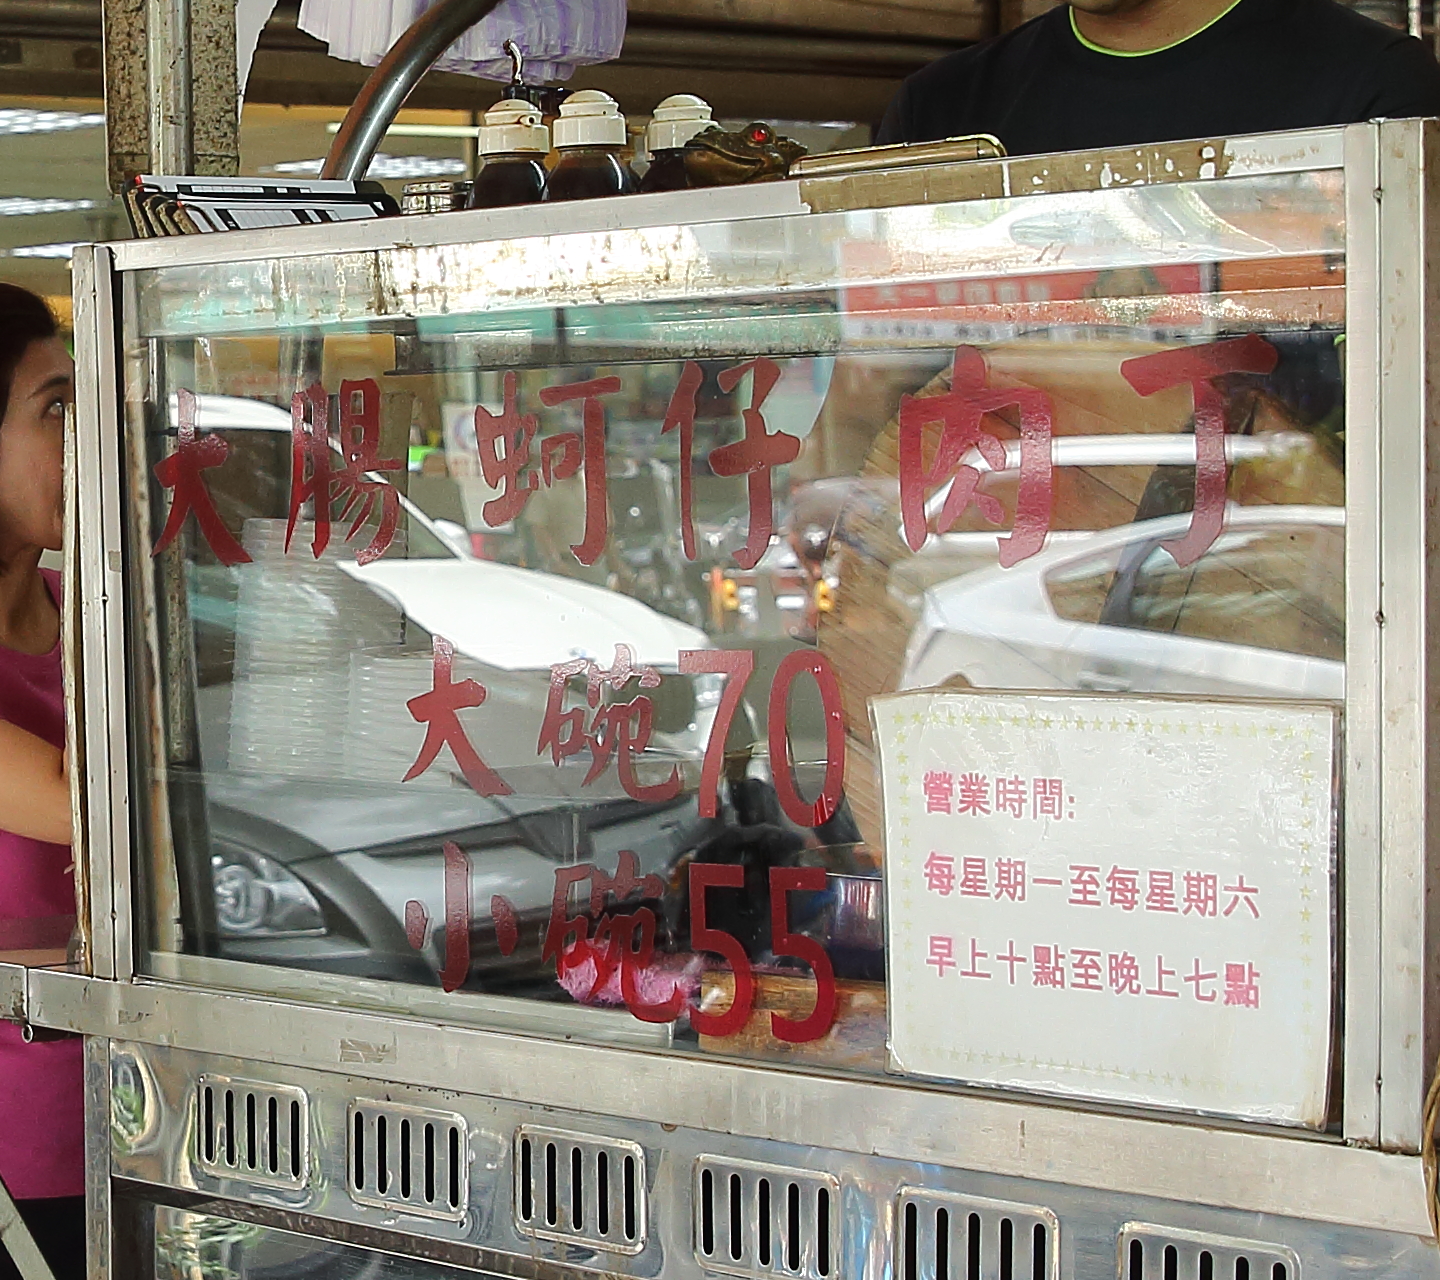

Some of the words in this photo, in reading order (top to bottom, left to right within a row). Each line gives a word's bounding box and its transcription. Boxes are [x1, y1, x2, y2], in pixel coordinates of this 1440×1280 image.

[922, 850, 1261, 920] 每星期一至每星期六
[924, 934, 1262, 1009] 早上十點至晚上七點
